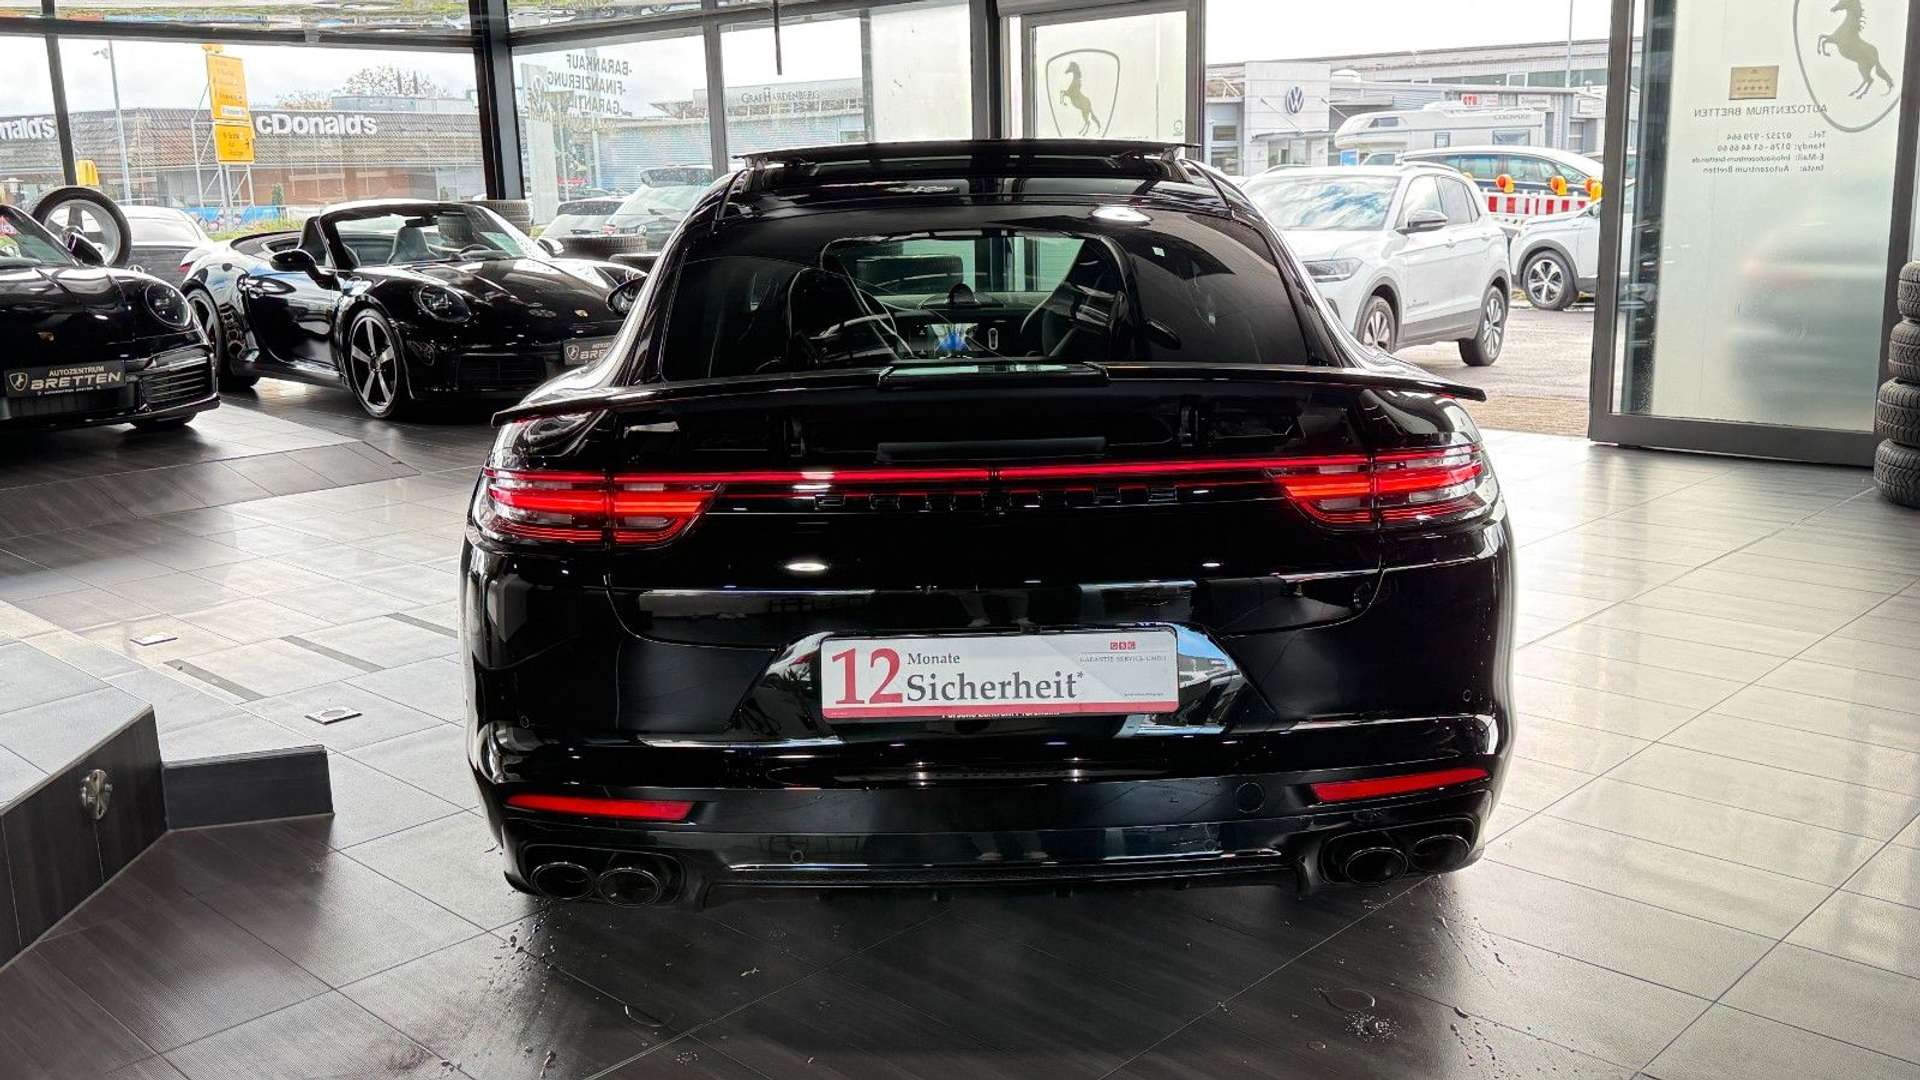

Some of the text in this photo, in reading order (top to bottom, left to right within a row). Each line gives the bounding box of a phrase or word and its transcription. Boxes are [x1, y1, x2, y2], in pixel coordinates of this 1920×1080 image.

[49, 365, 105, 377] AUTOZENTRUM
[30, 371, 121, 390] BRETTEN
[907, 652, 961, 665] Monate
[831, 647, 904, 705] 12
